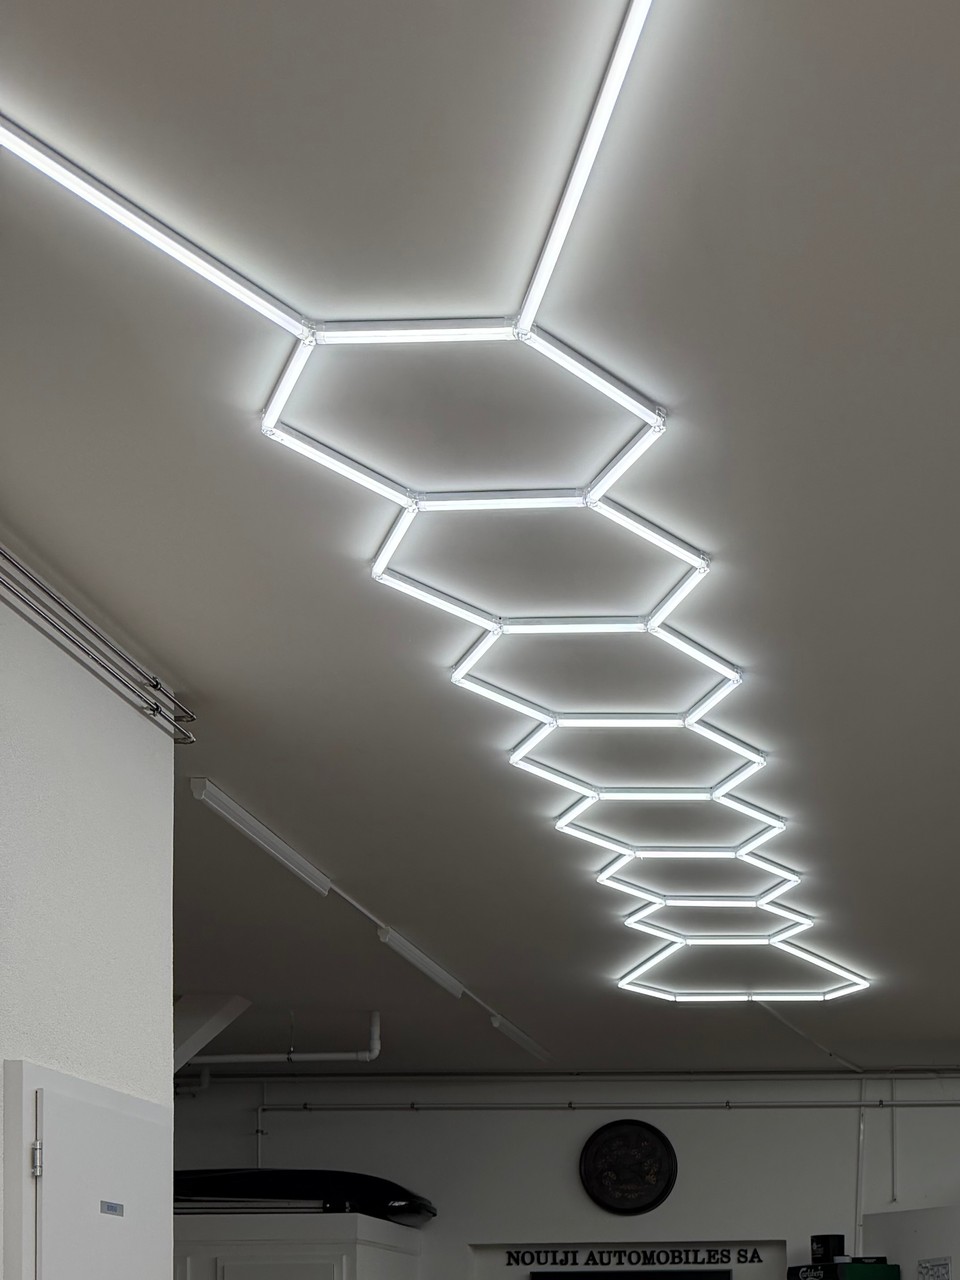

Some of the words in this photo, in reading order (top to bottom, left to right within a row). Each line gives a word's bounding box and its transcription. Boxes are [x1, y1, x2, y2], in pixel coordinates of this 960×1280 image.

[506, 1250, 579, 1267] NOUIJI
[583, 1249, 731, 1266] AUTOMOBILES
[737, 1248, 763, 1264] SA
